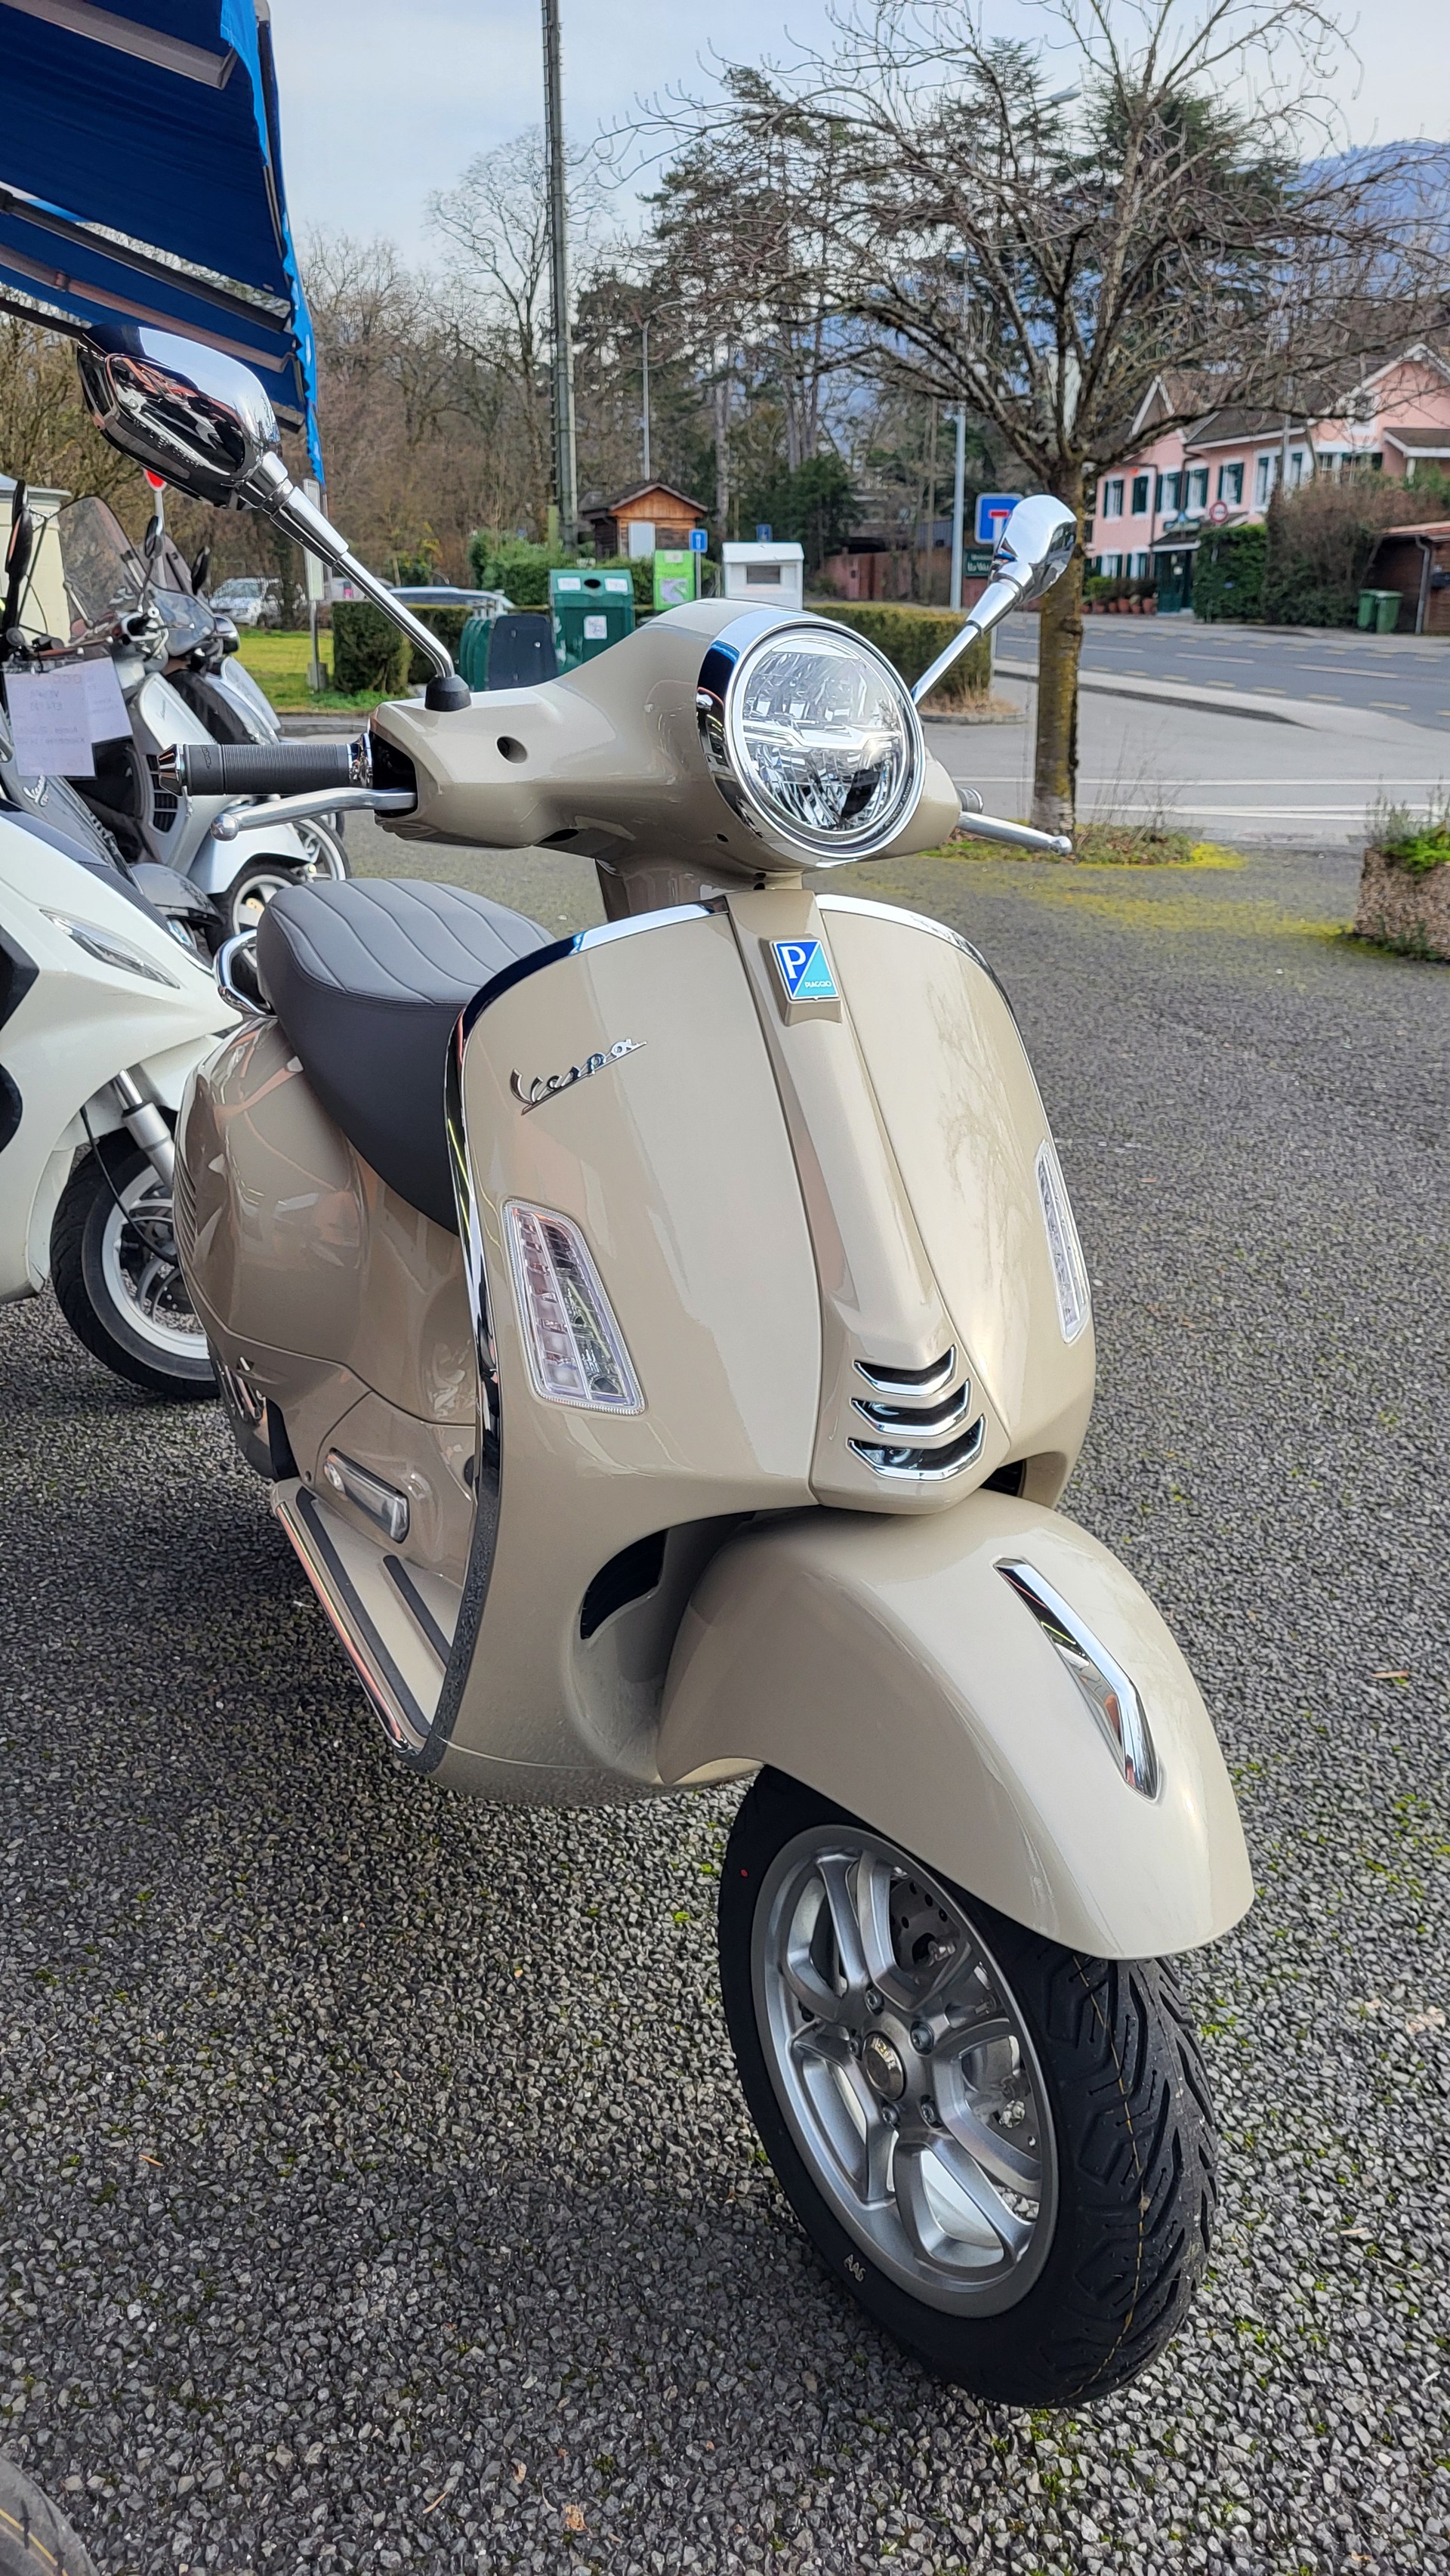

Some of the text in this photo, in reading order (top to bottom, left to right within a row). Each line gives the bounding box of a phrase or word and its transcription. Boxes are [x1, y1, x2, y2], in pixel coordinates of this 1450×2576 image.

[779, 946, 807, 979] P
[804, 980, 832, 989] PIAGGIO
[510, 1039, 647, 1116] Vespa
